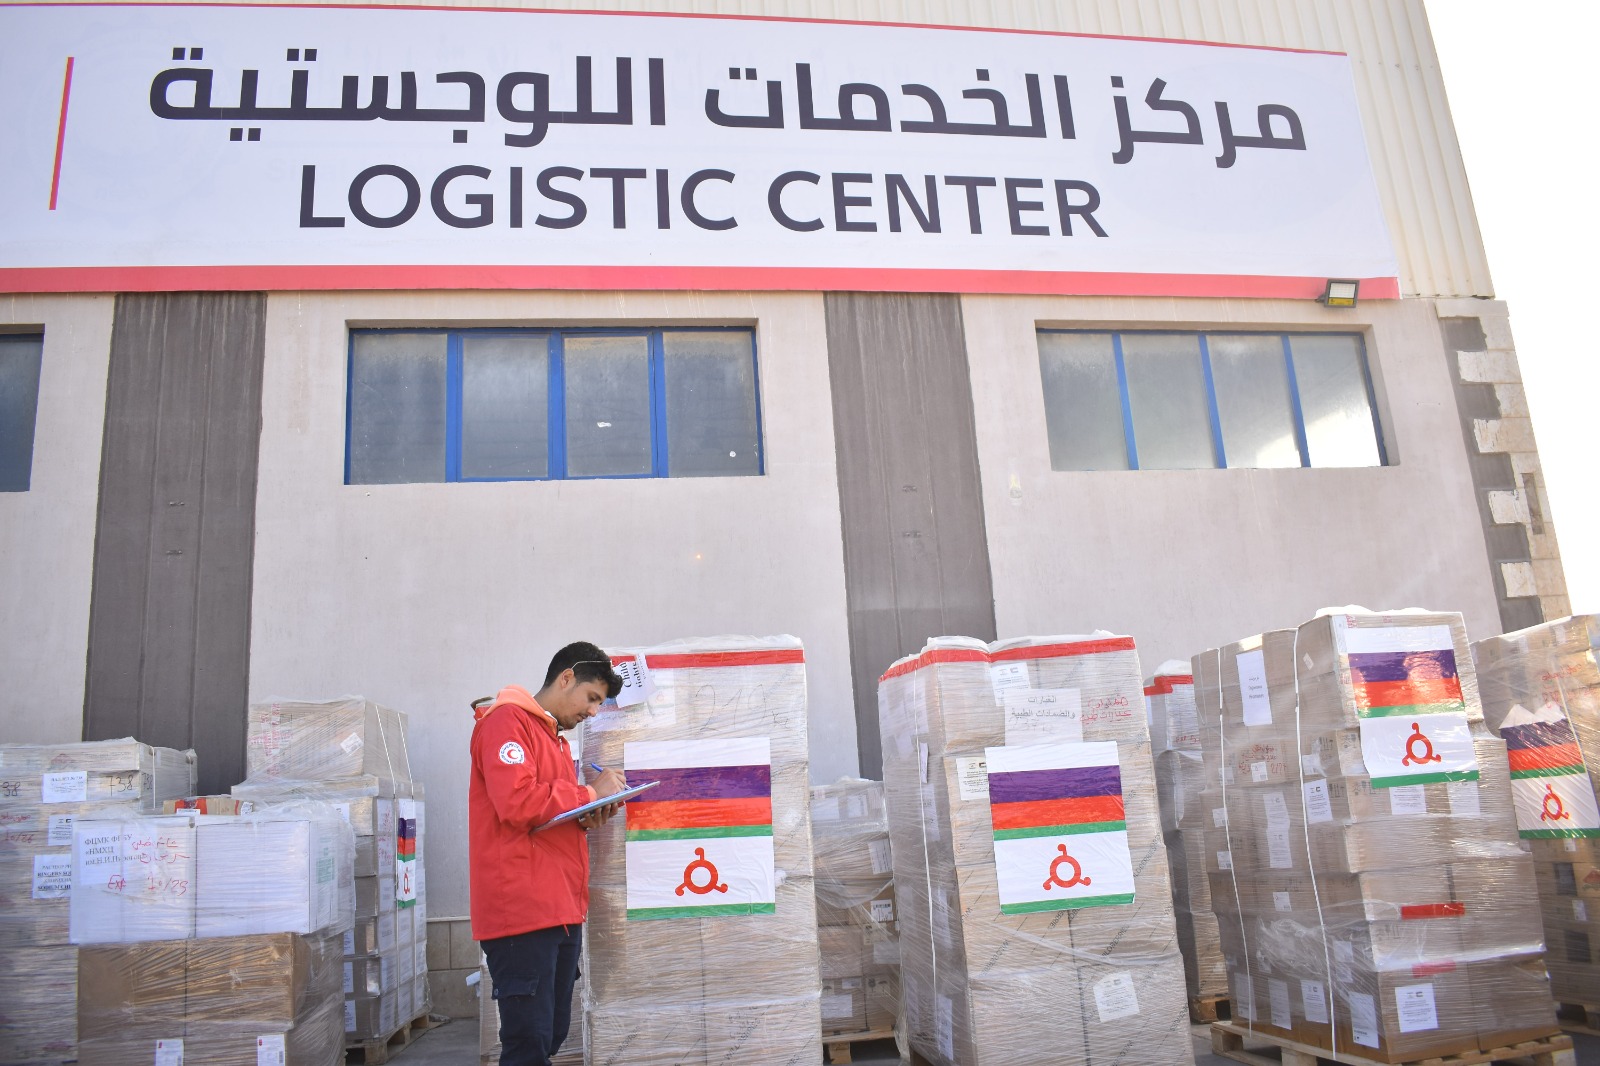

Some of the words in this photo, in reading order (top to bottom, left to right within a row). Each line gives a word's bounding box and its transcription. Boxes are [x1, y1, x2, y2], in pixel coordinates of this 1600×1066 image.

[150, 48, 666, 148] اللوجستية
[705, 63, 1076, 140] الخدمات
[1111, 76, 1307, 168] مركز
[300, 165, 739, 231] LOGISTIC
[768, 171, 1109, 238] CENTER
[620, 662, 632, 688] Child
[106, 775, 133, 797] 738
